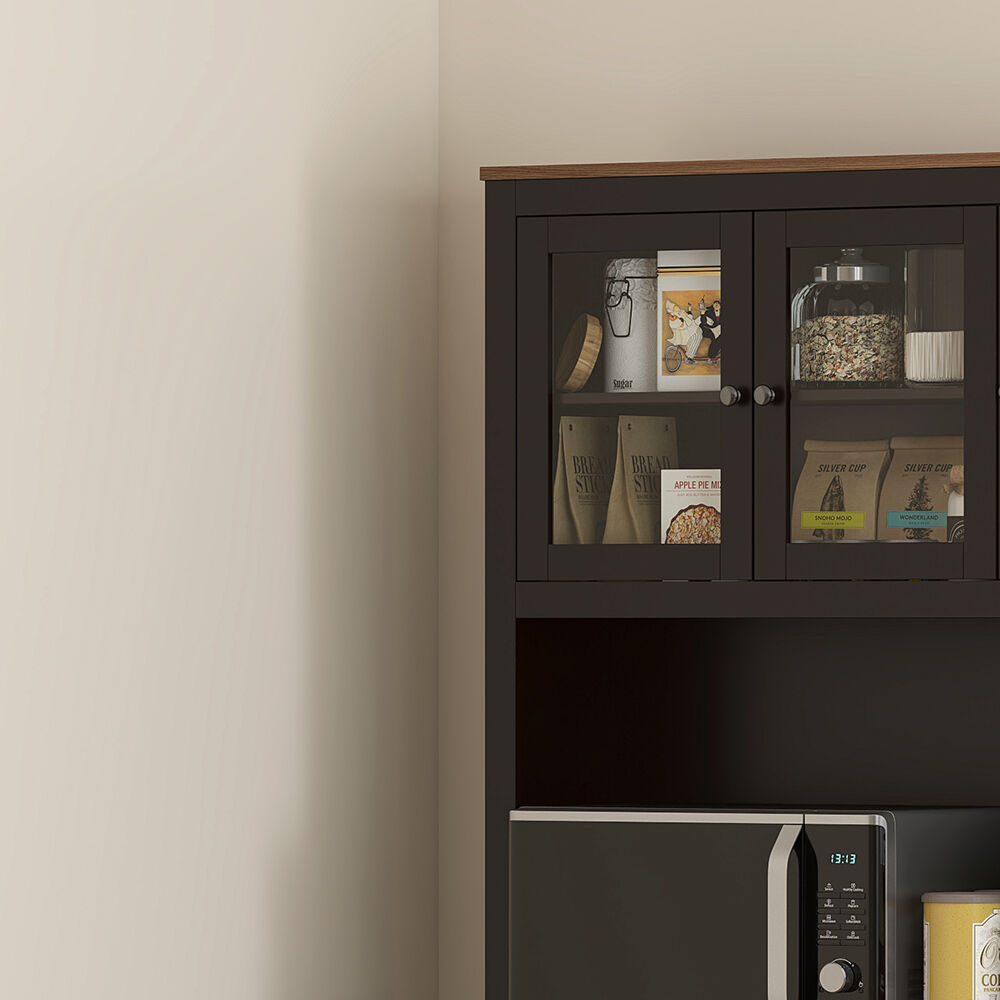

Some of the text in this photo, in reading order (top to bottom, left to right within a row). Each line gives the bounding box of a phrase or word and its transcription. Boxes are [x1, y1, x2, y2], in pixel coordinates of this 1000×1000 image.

[817, 463, 867, 473] SILVER CUP
[904, 463, 953, 473] SILVER CUP
[674, 480, 697, 489] APPLE
[698, 480, 709, 489] PIE
[831, 853, 857, 865] 13:13
